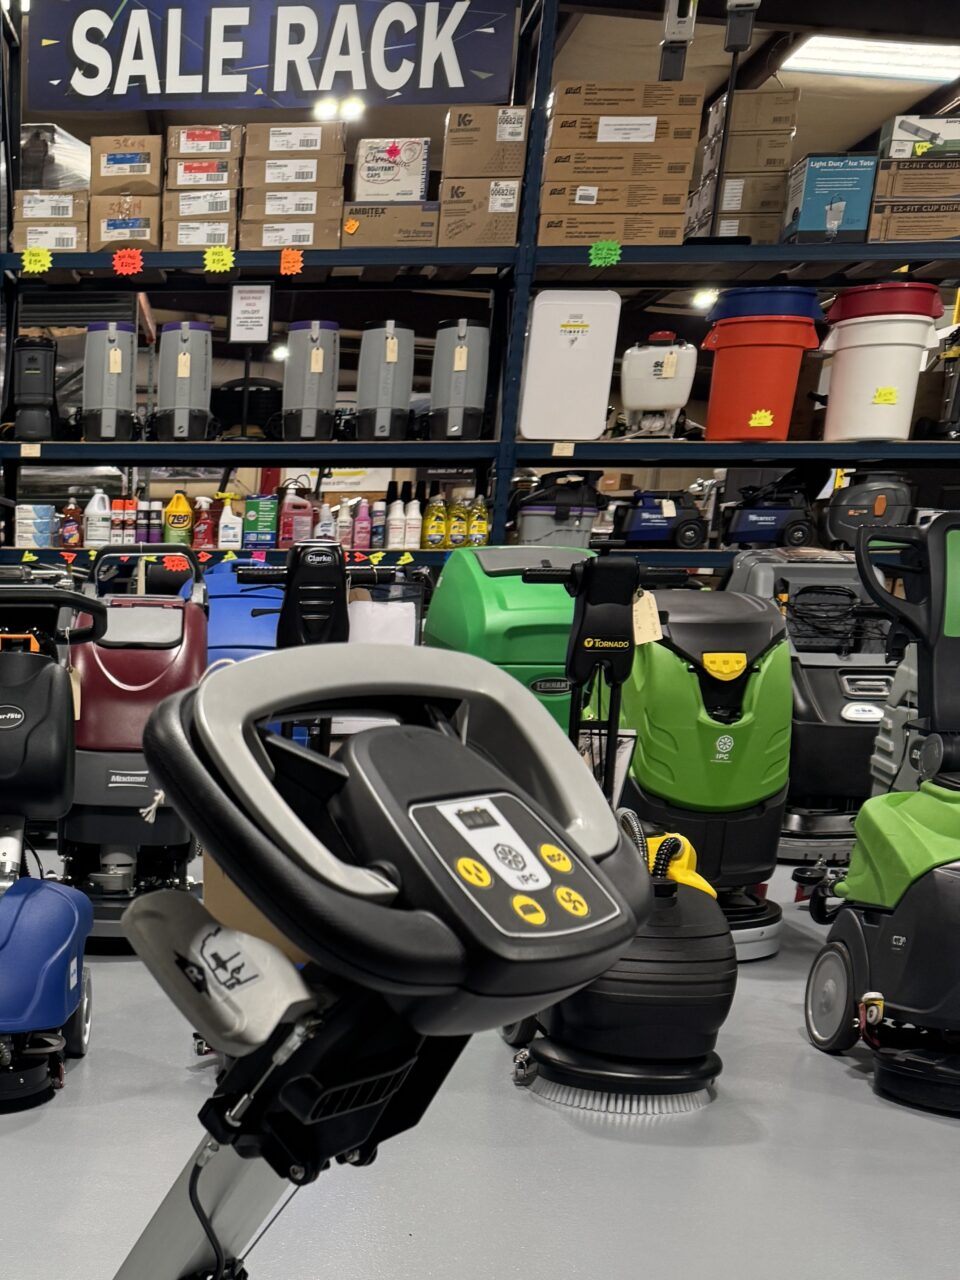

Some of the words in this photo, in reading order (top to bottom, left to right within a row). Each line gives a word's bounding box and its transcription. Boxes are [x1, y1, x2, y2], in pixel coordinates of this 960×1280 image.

[70, 6, 250, 97] SALE
[273, 0, 470, 92] RACK
[810, 160, 827, 168] Light
[349, 207, 387, 216] AMBITEX
[307, 554, 332, 563] Clarke
[516, 872, 540, 887] IPC
